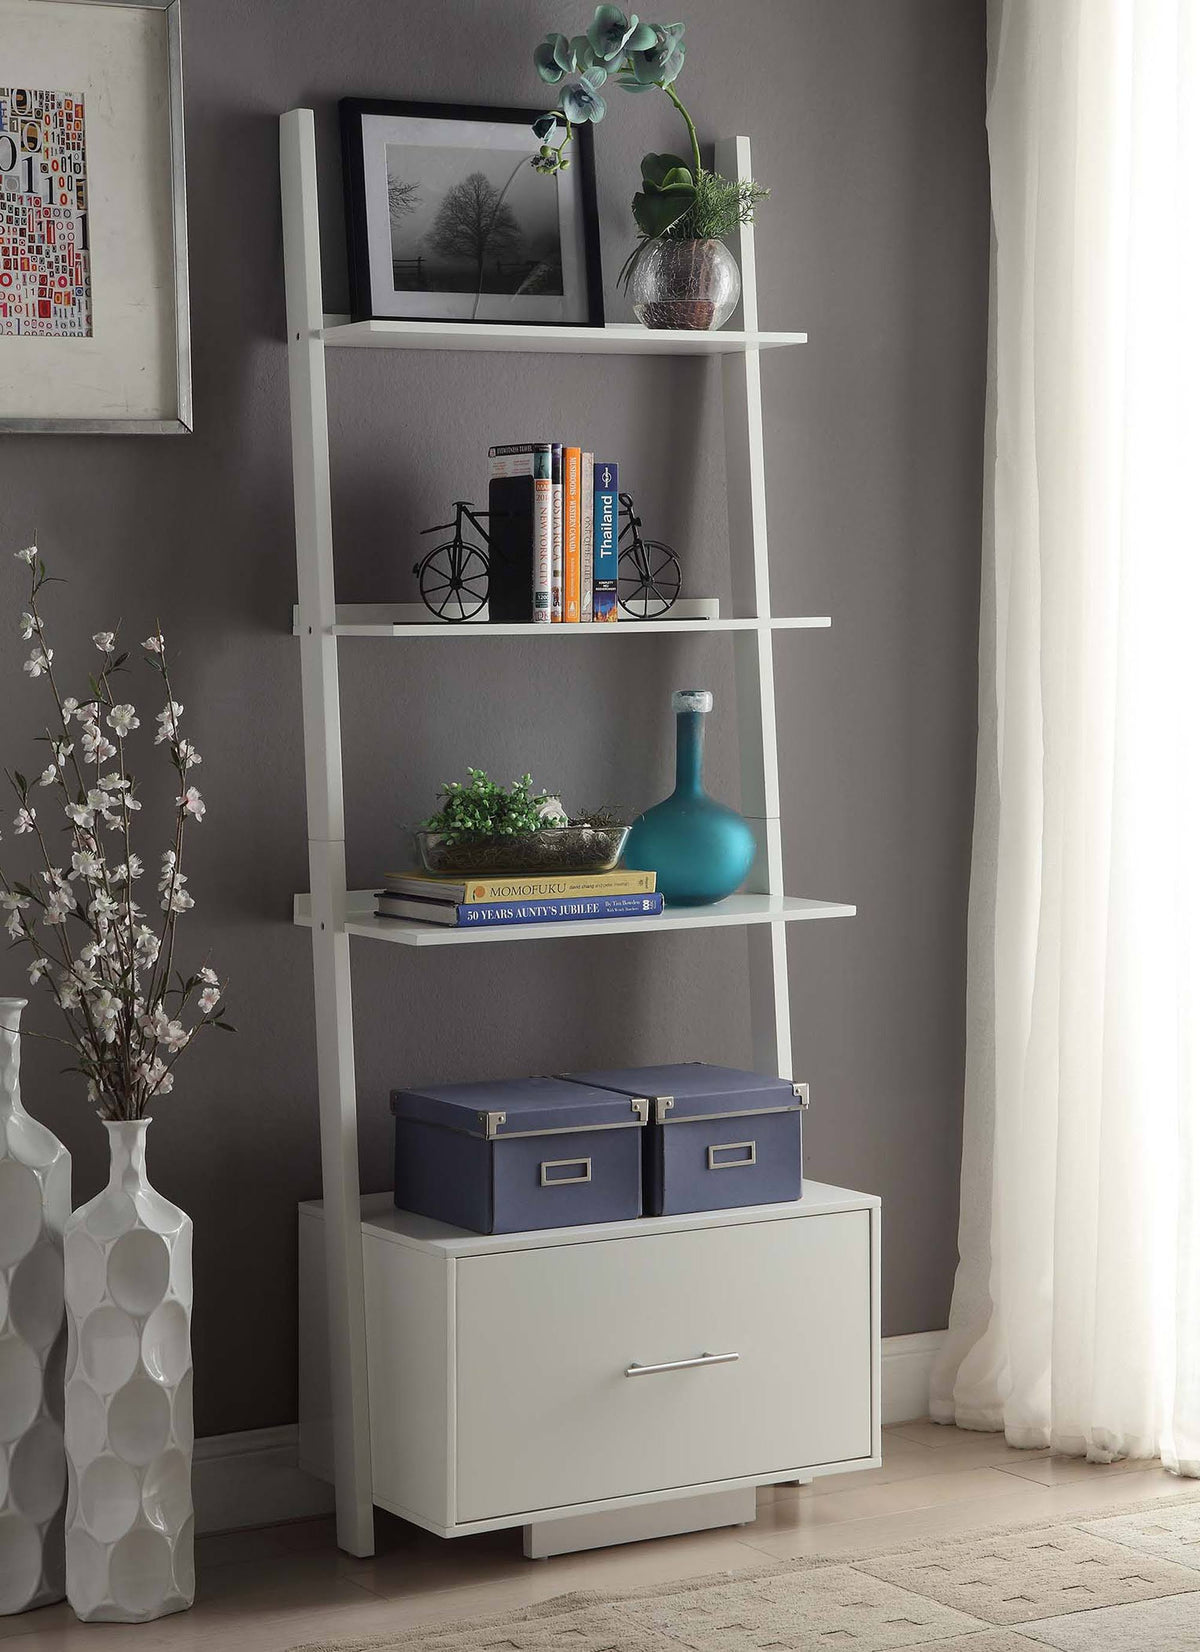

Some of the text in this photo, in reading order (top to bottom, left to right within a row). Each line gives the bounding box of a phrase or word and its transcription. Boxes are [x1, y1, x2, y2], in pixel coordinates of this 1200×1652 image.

[553, 490, 561, 561] COSTA RICA
[584, 516, 592, 535] ONE
[601, 496, 612, 559] Thailand
[540, 507, 548, 586] NEW YORK CITY
[490, 883, 566, 897] MOMOFUKU
[467, 903, 600, 920] 50 YEARS AUNTY'S JUBILEE
